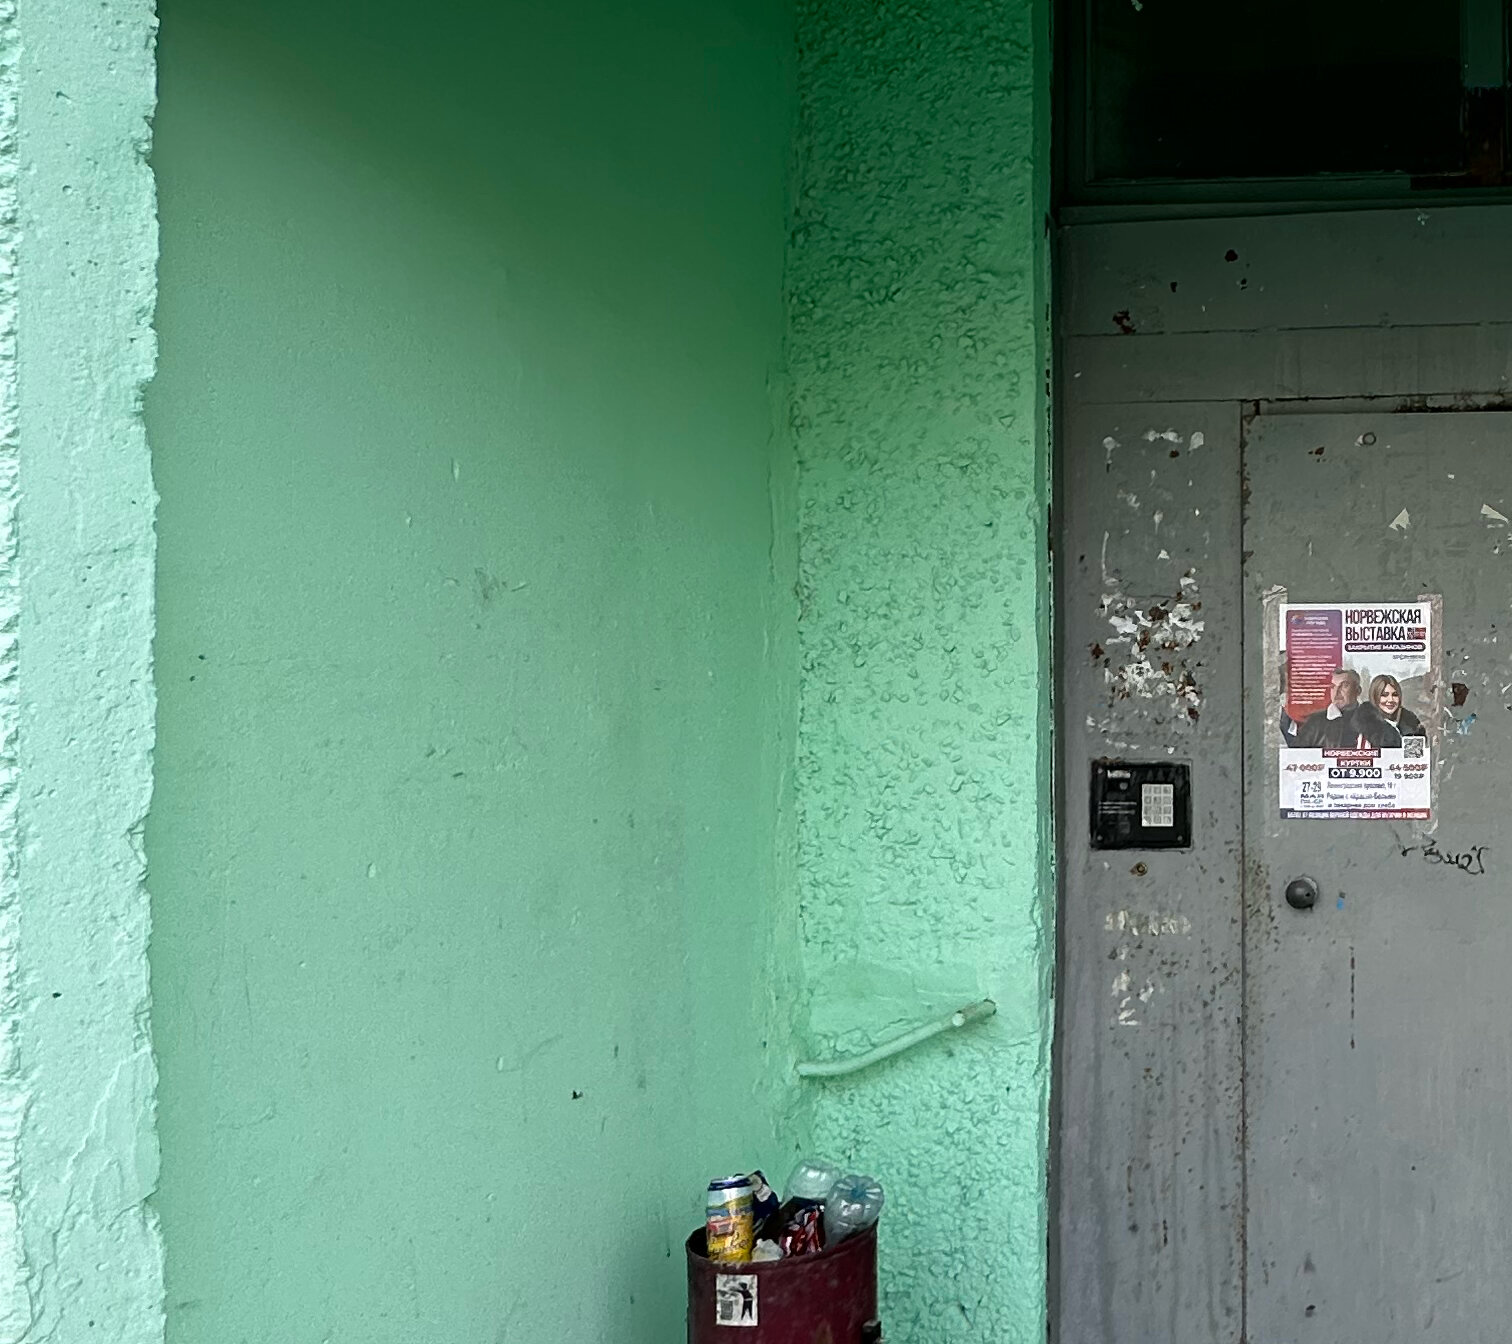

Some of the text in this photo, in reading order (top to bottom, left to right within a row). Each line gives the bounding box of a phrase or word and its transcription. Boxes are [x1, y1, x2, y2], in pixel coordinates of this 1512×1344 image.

[1345, 608, 1422, 625] НОРВЕЖСКАЯ
[1345, 626, 1406, 641] ВЫСТАВКА
[1331, 768, 1381, 777] ОТ 9.900
